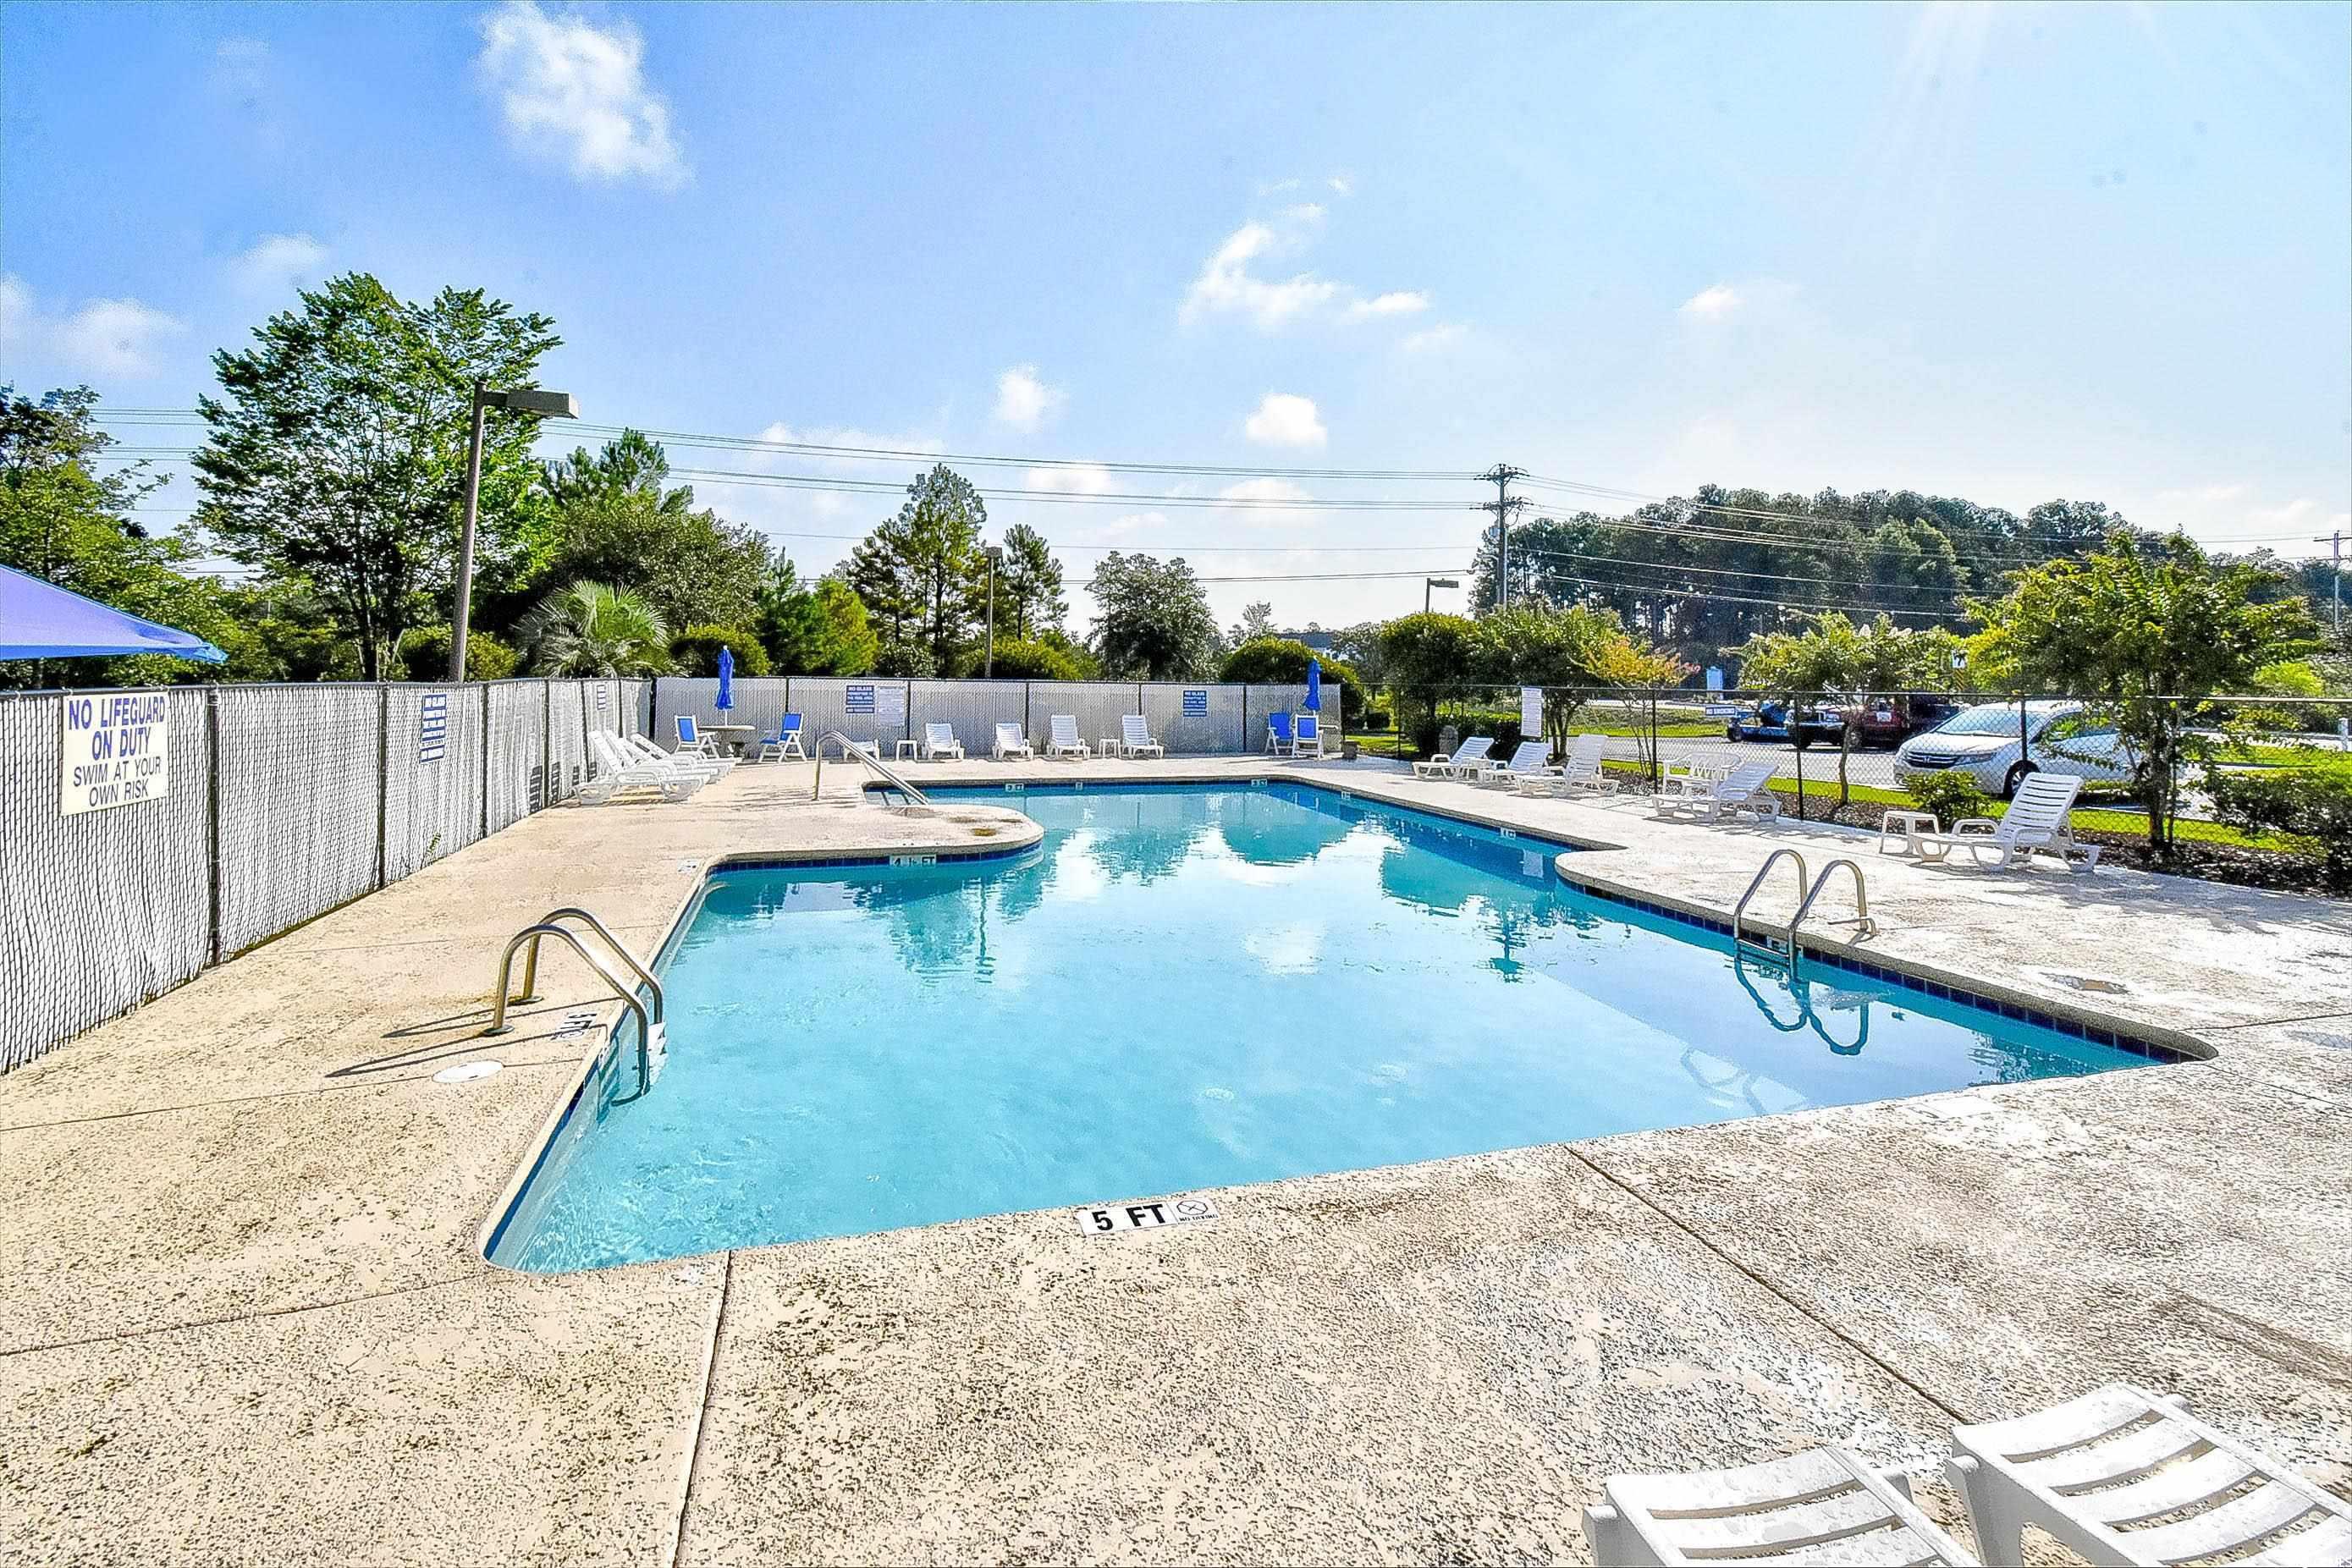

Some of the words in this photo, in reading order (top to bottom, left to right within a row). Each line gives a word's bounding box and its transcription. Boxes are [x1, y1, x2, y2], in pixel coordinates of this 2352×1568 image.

[69, 699, 92, 729] NO
[101, 696, 165, 727] LIFEGUARD
[92, 730, 113, 761] ON
[119, 727, 151, 757] DUTY
[74, 763, 108, 787] SWIM
[113, 761, 129, 781] AT
[135, 756, 161, 777] YOUR
[89, 784, 118, 806] OWN
[124, 778, 149, 801] RISK
[922, 856, 935, 867] FT
[1092, 1210, 1113, 1230] 5
[1126, 1204, 1165, 1226] FT
